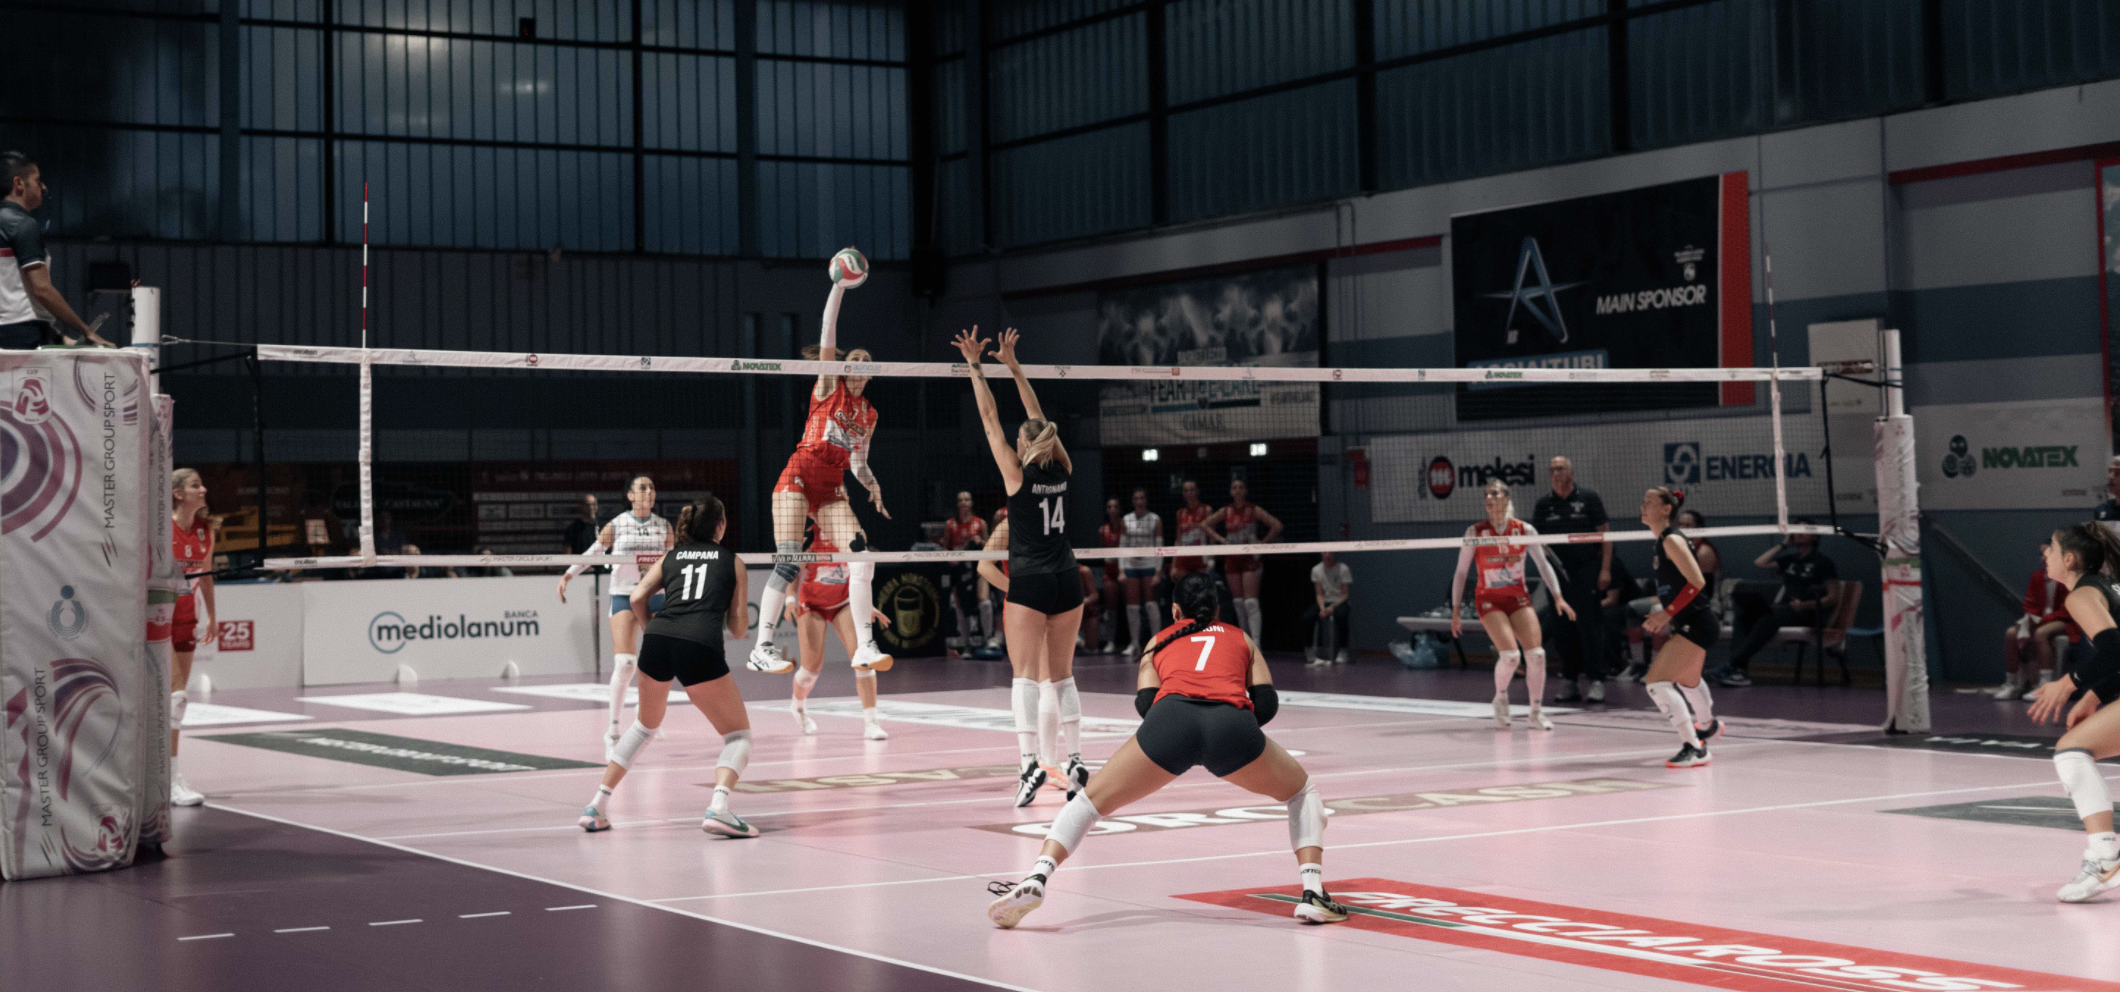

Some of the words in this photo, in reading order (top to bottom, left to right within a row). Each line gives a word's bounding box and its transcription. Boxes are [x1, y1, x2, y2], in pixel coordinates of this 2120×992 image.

[1596, 293, 1635, 315] MAIN
[1636, 284, 1706, 310] SPONSOR
[743, 362, 781, 371] NOVATEX
[103, 372, 115, 418] SPORT
[103, 419, 115, 471] GROUP
[157, 434, 165, 463] SPORT
[1982, 446, 2079, 468] NOVATEX
[157, 464, 165, 498] GROUP
[1458, 454, 1535, 488] melesi
[103, 473, 115, 529] MASTER
[157, 500, 165, 536] MASTER
[1038, 495, 1066, 536] 14
[676, 551, 718, 560] CAMPANA
[680, 563, 709, 601] 11
[377, 614, 540, 641] mediolanum
[504, 610, 539, 618] BANCA
[223, 622, 250, 641] 25
[1190, 636, 1216, 671] 7
[34, 667, 47, 713] SPORT
[156, 674, 164, 702] SPORT
[156, 702, 165, 736] GROUP
[36, 715, 49, 768] GROUP
[157, 738, 166, 774] MASTER
[36, 770, 53, 827] MASTER
[1328, 891, 2028, 990] FRECCIAROSS
